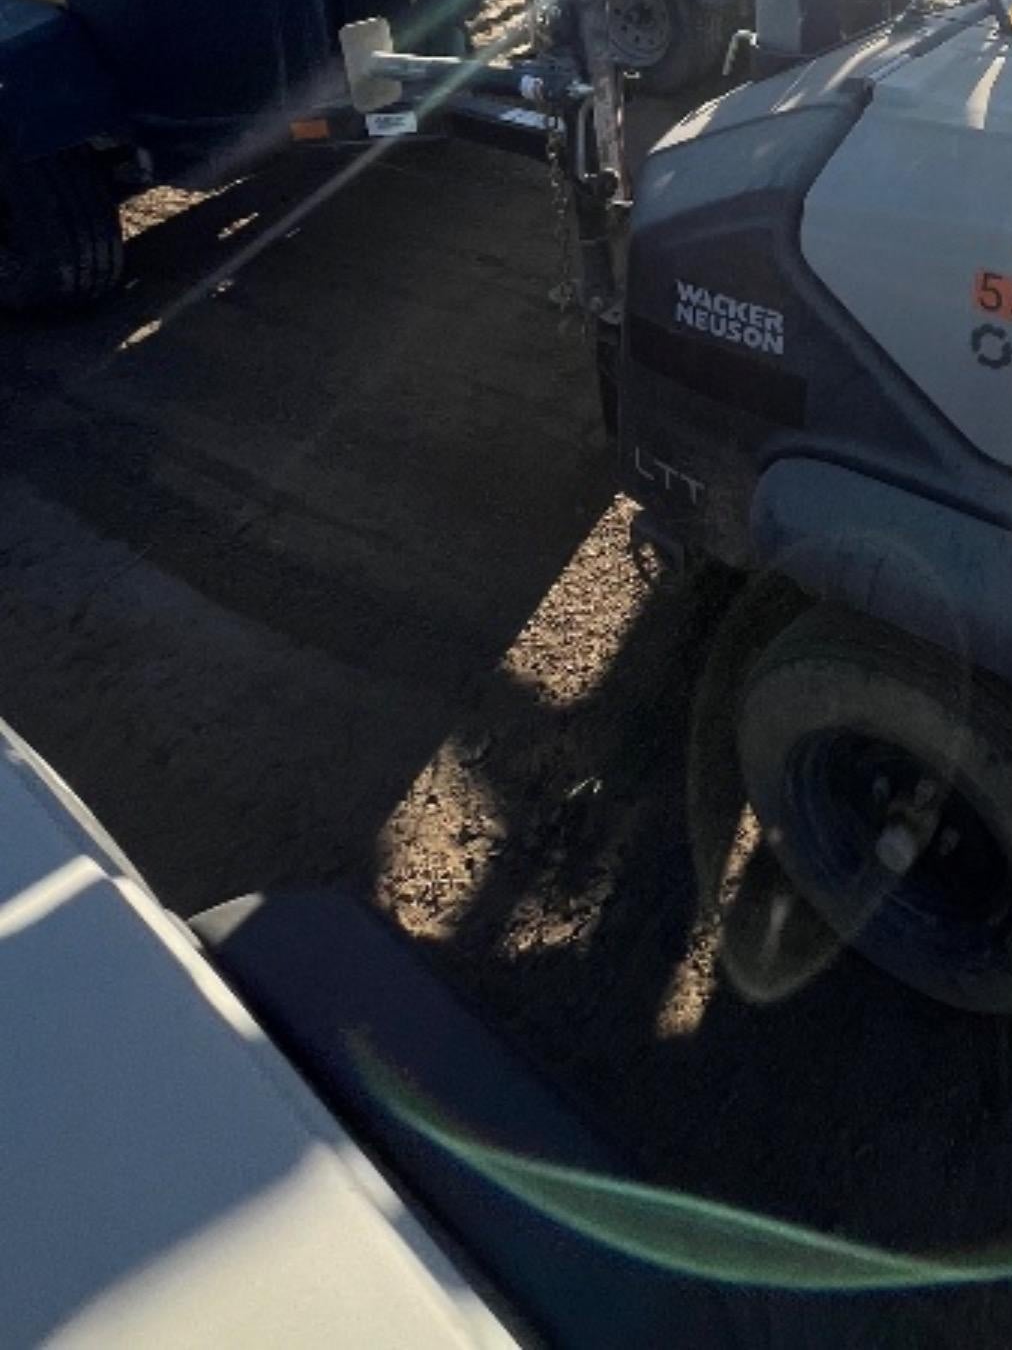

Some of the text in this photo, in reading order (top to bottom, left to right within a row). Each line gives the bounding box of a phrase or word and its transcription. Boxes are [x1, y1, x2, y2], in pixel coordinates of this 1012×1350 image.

[675, 302, 785, 355] NEUSON
[676, 278, 785, 334] WACKER
[635, 446, 706, 505] LTT
